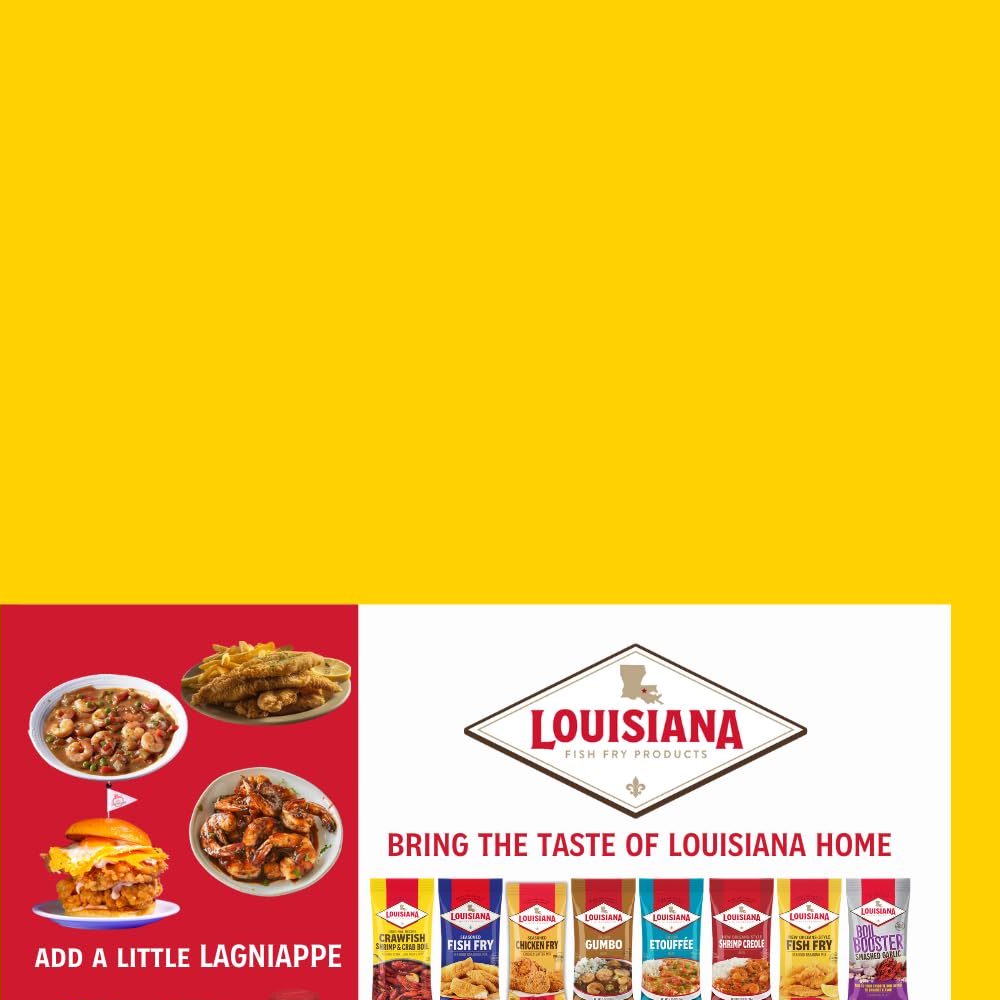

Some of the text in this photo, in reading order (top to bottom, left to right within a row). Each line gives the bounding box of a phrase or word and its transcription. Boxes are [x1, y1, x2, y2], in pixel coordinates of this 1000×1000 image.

[531, 709, 744, 750] LOUISIANA
[565, 750, 707, 758] FISH FRY PRODUCTS
[389, 833, 891, 856] BRING THE TASTE OF LOUISIANA HOME
[856, 924, 875, 938] BOIL
[379, 934, 425, 942] CRAWFISH
[650, 937, 694, 949] ETOUFFÉE
[447, 940, 494, 950] FISH FRY
[516, 940, 558, 949] CHICKEN FRY
[585, 940, 623, 949] GUMBO
[719, 940, 765, 948] SHRIMP CREOLE
[786, 940, 832, 950] FISH FRY
[853, 934, 904, 953] BOOSTER
[35, 944, 341, 967] ADD A LITTLE LAGNIAPPE
